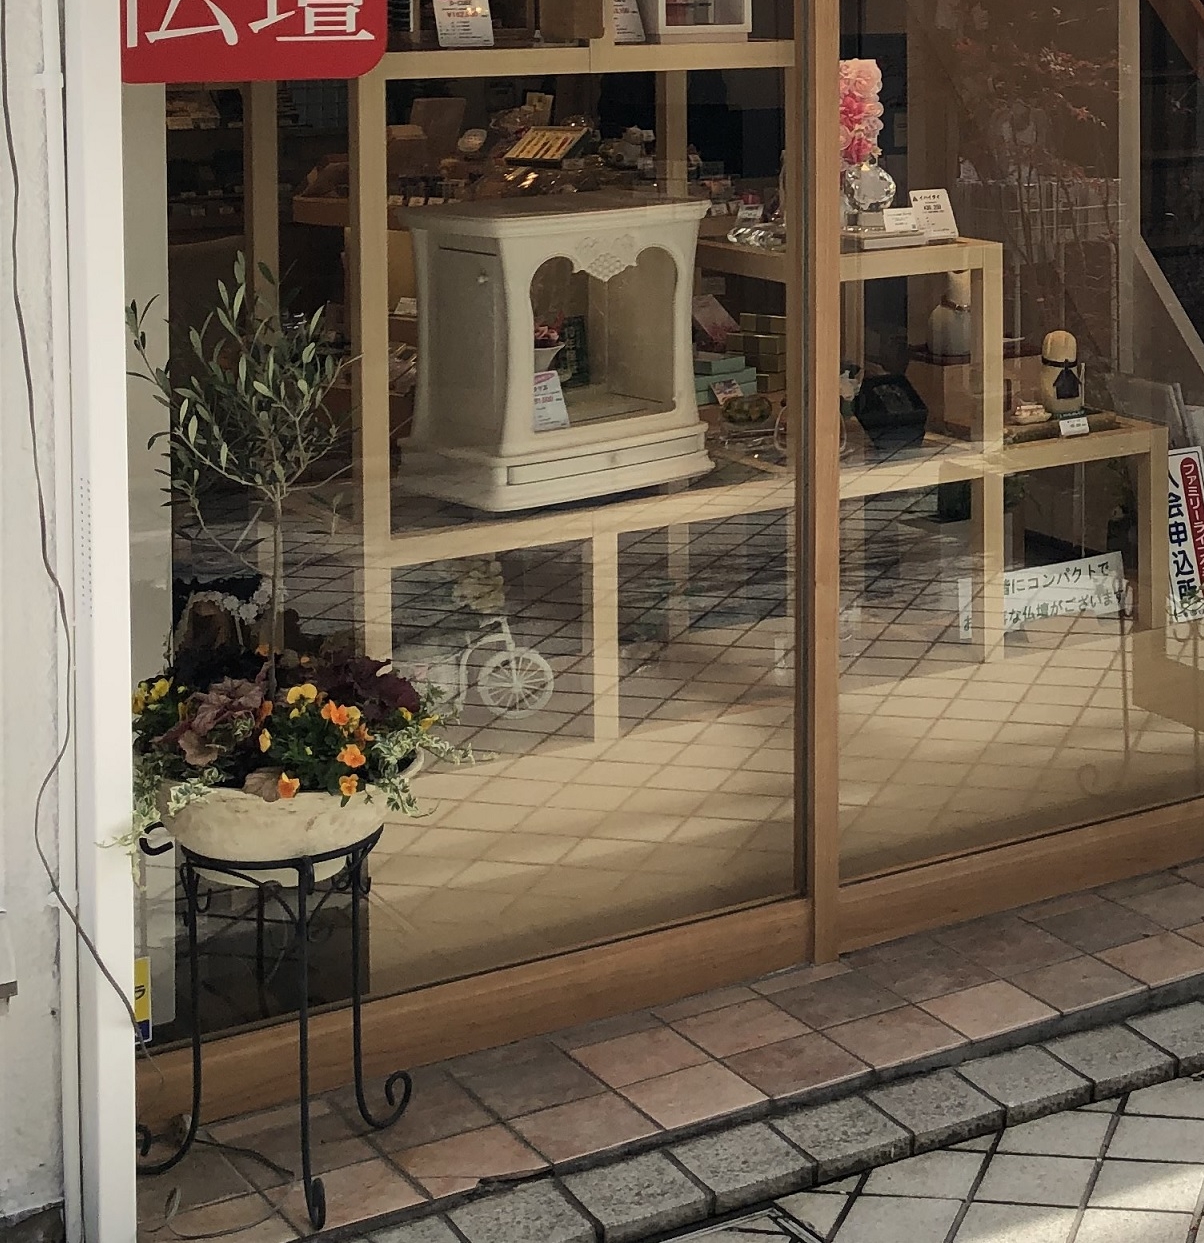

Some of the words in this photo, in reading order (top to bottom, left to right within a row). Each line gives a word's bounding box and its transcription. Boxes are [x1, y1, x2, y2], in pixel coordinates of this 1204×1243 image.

[1004, 589, 1124, 624] な仏壇がございます
